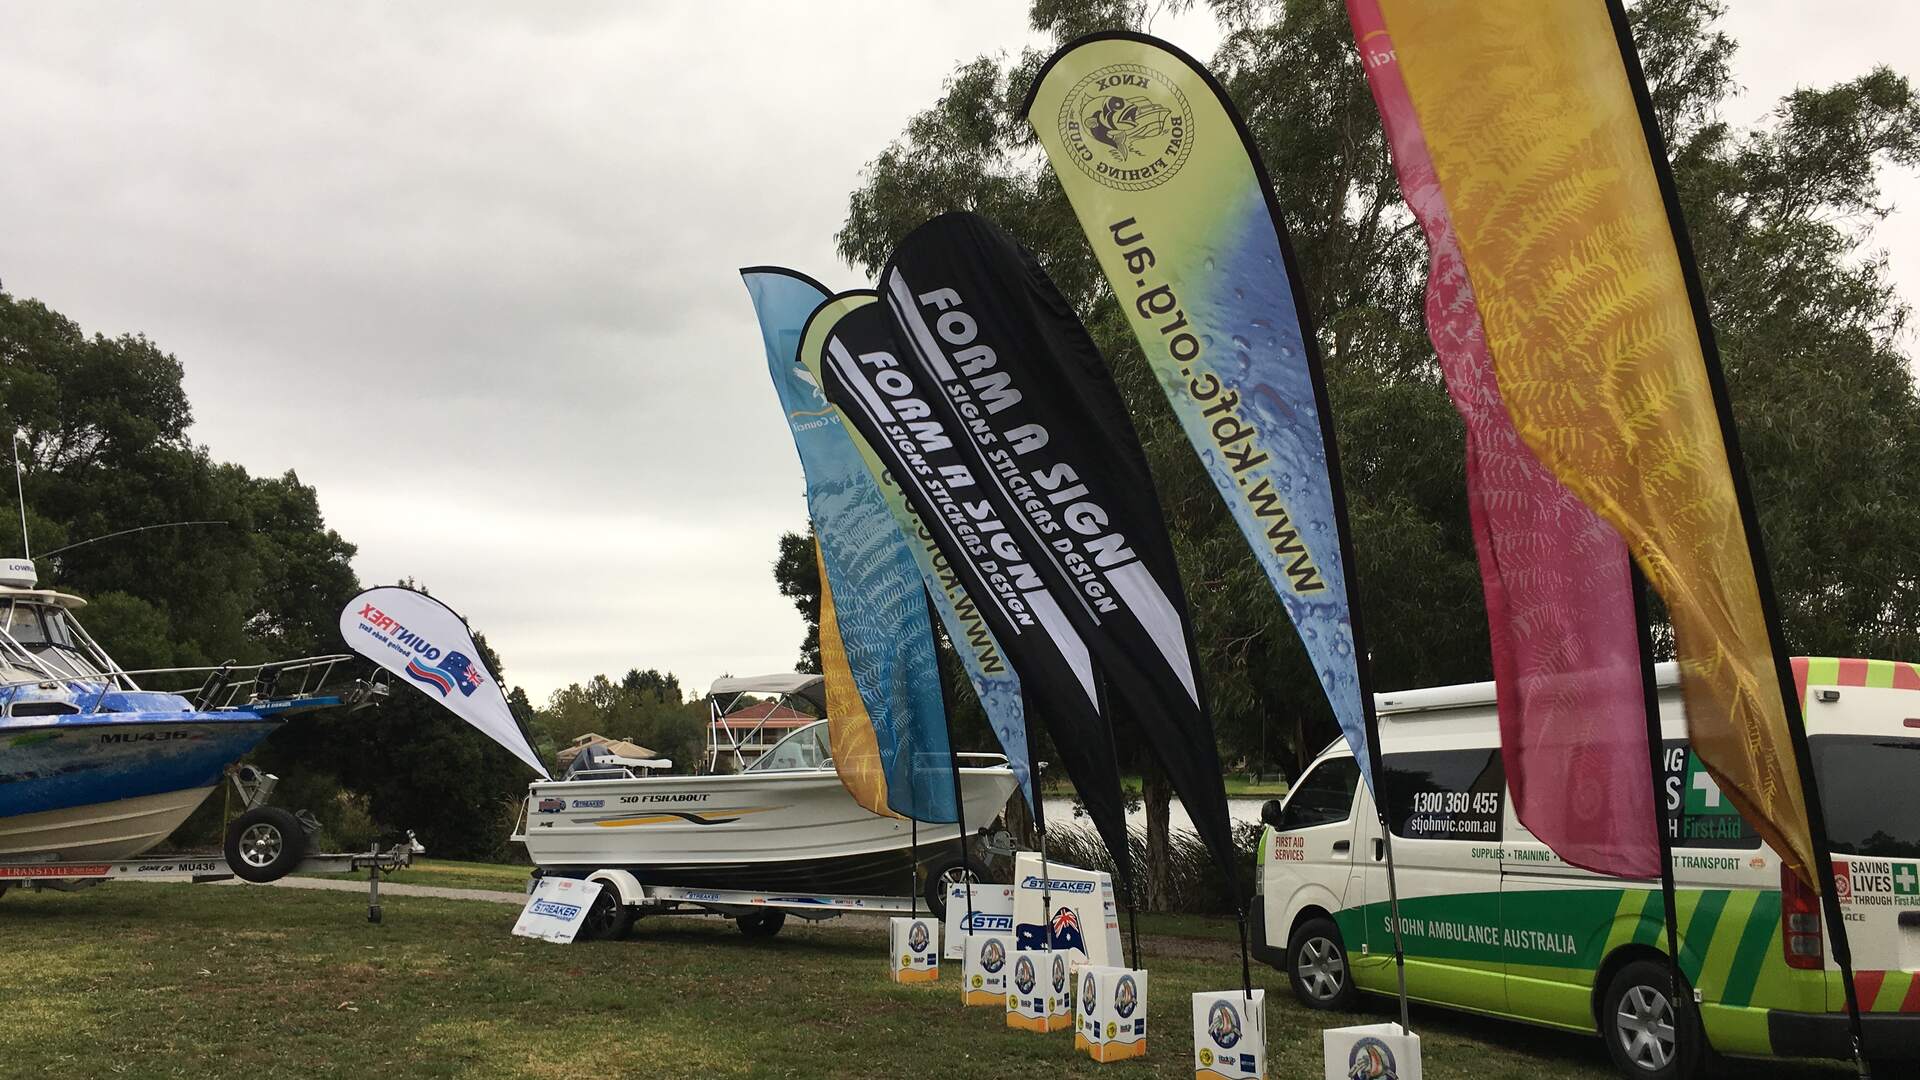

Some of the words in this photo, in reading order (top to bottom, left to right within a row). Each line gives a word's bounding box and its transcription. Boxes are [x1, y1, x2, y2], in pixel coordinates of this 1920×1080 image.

[918, 287, 1023, 415] FORM
[1003, 423, 1049, 456] A
[1030, 462, 1137, 568] SIGN
[858, 351, 953, 453] FORM
[938, 464, 976, 488] A
[962, 500, 1044, 593] SIGN
[947, 383, 998, 446] SIGNS
[988, 449, 1061, 536] STICKERS
[1051, 537, 1119, 614] DESIGN
[886, 425, 934, 476] SIGNS
[925, 480, 989, 557] STICKERS
[979, 559, 1035, 626] DESIGN
[101, 730, 188, 744] MU436
[620, 796, 638, 804] 510
[641, 793, 710, 803] FISHABOUT
[1413, 792, 1443, 812] 1300
[1445, 792, 1469, 813] 360
[1472, 792, 1498, 813] 455
[1411, 815, 1496, 834] stjohnvic.com.au
[1684, 817, 1714, 839] First
[1719, 816, 1741, 839] Aid
[1275, 836, 1292, 848] FIRST
[1293, 836, 1304, 848] AID
[1275, 849, 1304, 861] SERVICES
[1471, 848, 1505, 860] SUPPLIES
[1514, 850, 1550, 861] TRAINING
[1681, 856, 1741, 870] TRANSPORT
[178, 863, 216, 872] MU436
[1851, 862, 1890, 874] SAVING
[1029, 880, 1093, 890] STREAKER
[1853, 876, 1892, 892] LIVES
[1854, 896, 1893, 905] THROUGH
[535, 903, 578, 918] STREAKER
[1428, 920, 1499, 945] AMBULANCE
[1504, 928, 1577, 954] AUSTRALIA
